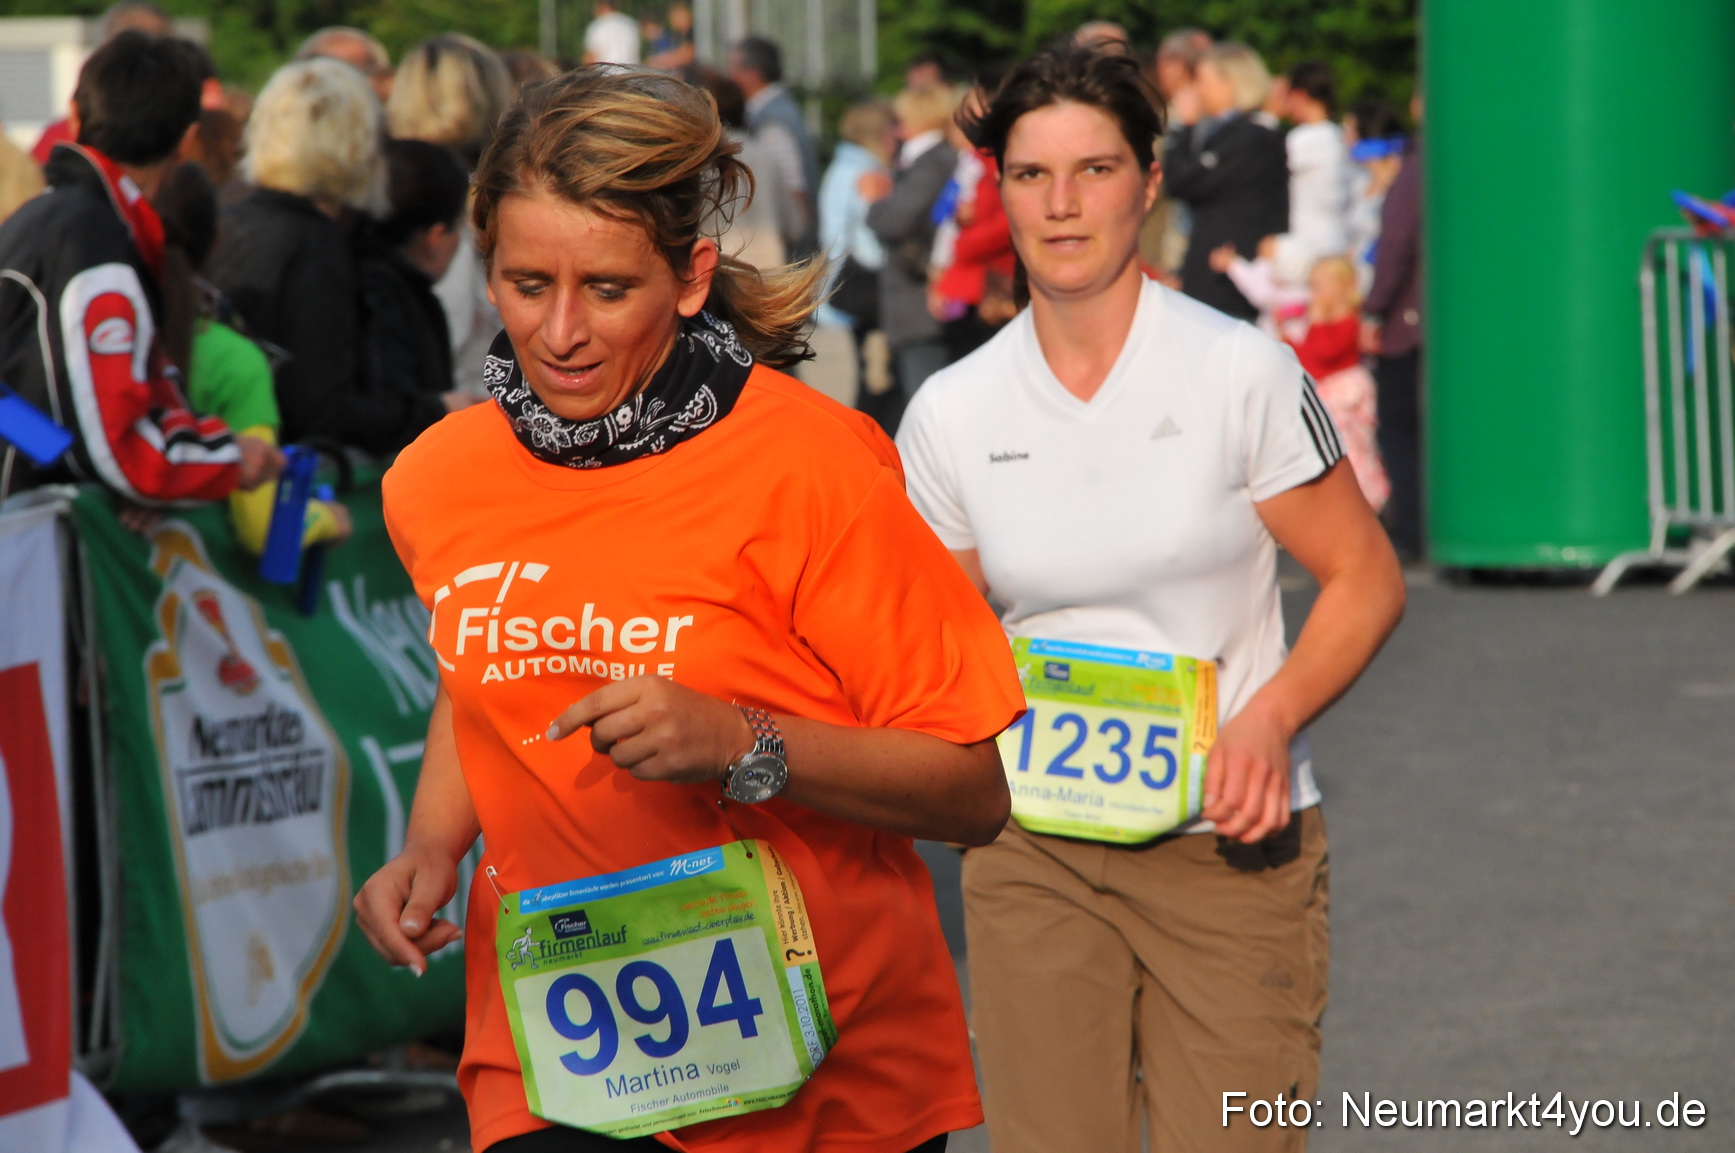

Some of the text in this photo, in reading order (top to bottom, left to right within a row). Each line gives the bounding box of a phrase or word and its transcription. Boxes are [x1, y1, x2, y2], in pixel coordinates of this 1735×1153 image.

[456, 603, 694, 656] Fischer
[1008, 706, 1178, 790] 1235
[781, 881, 791, 904] Aktion
[540, 925, 627, 958] firmenlauf
[788, 910, 798, 943] Werbung
[545, 937, 764, 1076] 994
[605, 1059, 740, 1098] Martina Vogel
[630, 1084, 729, 1113] Fischer Automobile
